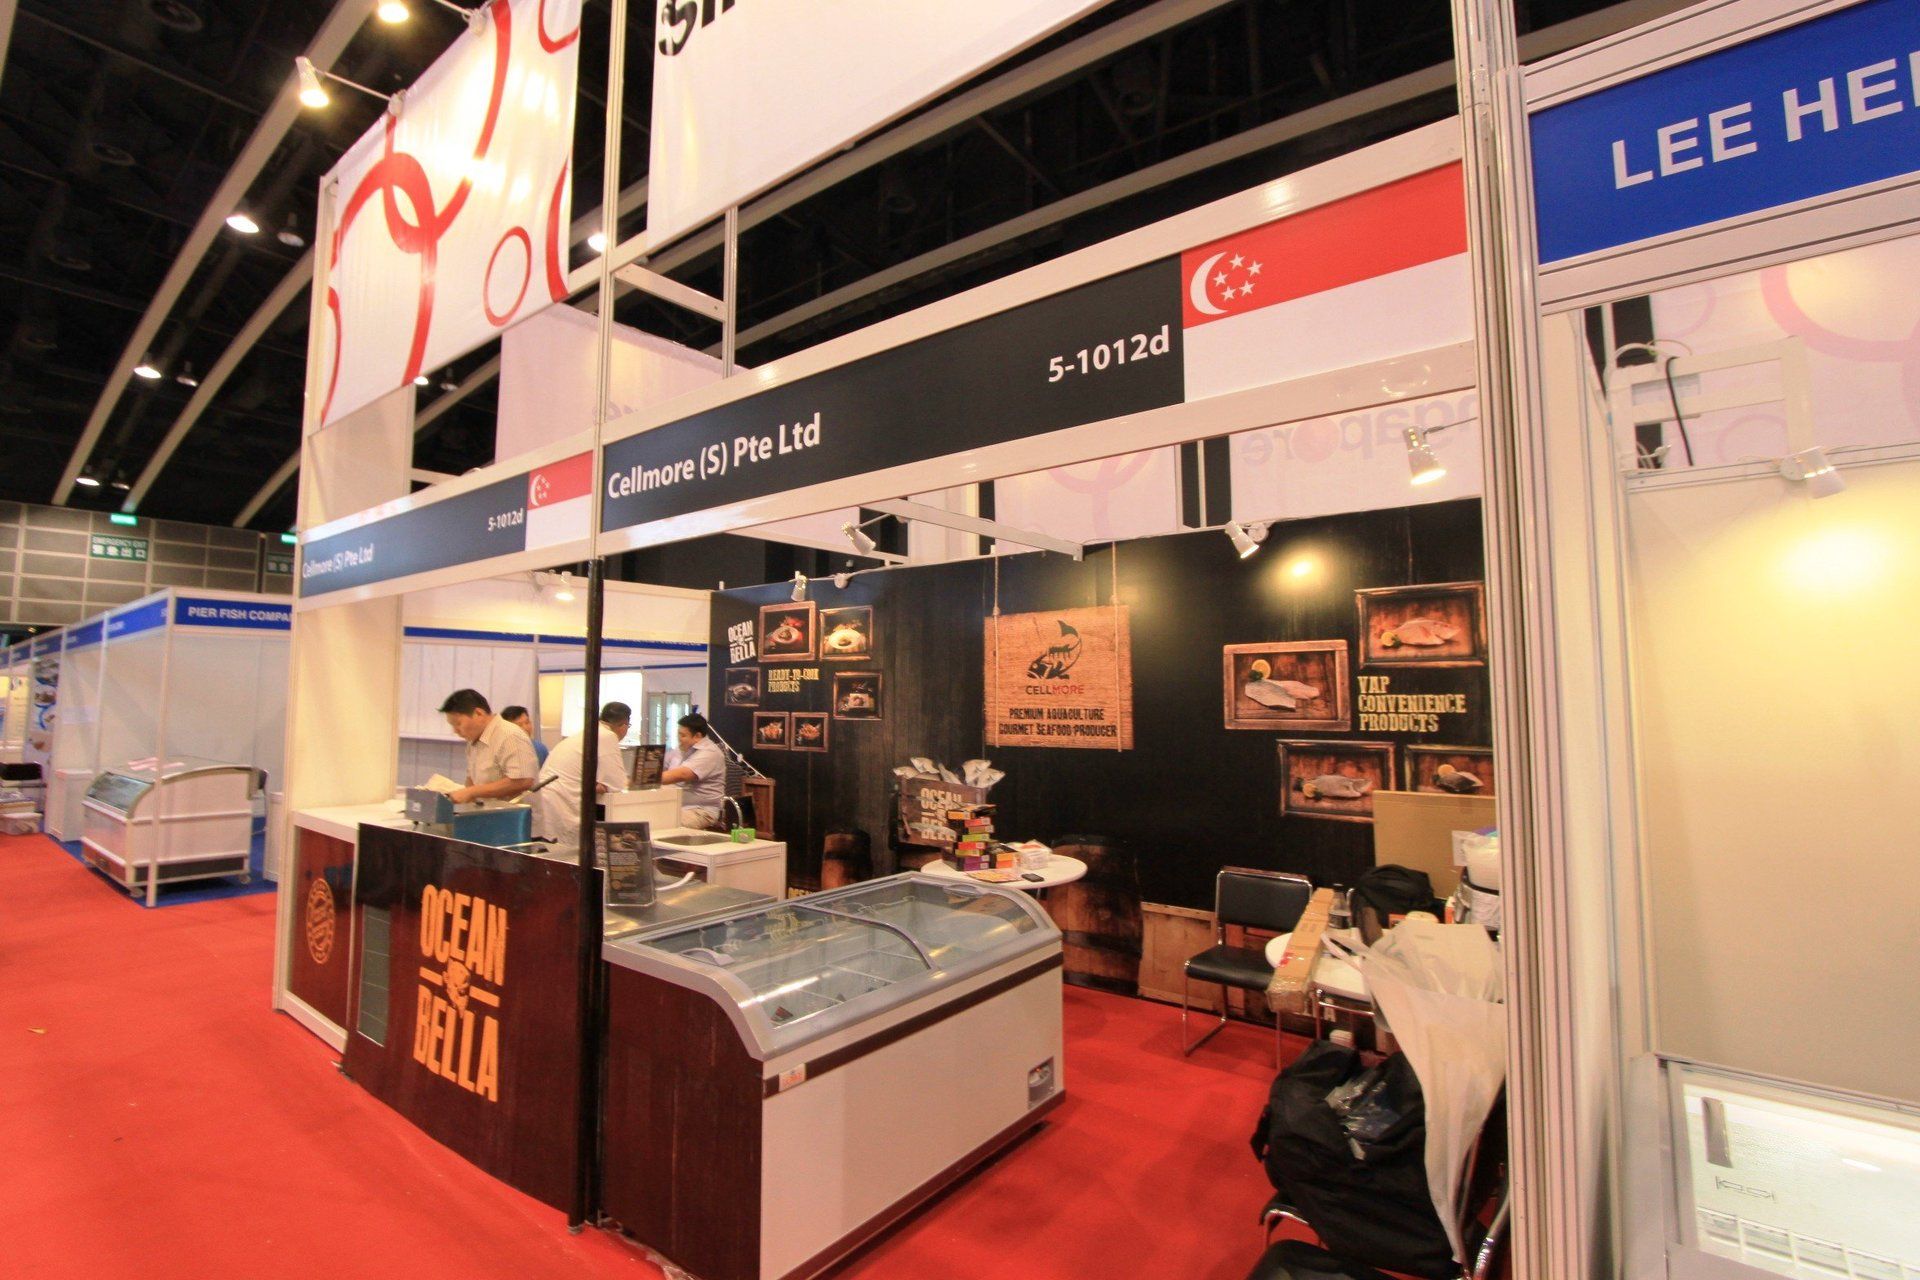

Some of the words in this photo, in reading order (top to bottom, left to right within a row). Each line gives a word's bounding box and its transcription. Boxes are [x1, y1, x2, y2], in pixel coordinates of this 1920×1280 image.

[1612, 102, 1758, 190] LEE
[1783, 50, 1920, 143] HE
[1048, 324, 1171, 383] 5-1012d
[607, 458, 696, 499] Cellmore
[700, 441, 728, 481] (S)
[734, 436, 773, 467] Pte
[779, 411, 821, 455] Ltd
[488, 508, 523, 531] 5-1012d
[303, 559, 333, 578] Cellmore
[333, 552, 343, 573] (S)
[344, 550, 358, 568] Pte
[359, 542, 374, 564] Ltd
[188, 606, 217, 618] PIER
[219, 608, 247, 620] FISH
[248, 610, 292, 622] COMPA
[728, 620, 753, 643] OCEAN
[730, 641, 756, 664] BELLA
[1026, 685, 1084, 695] CELLMORE
[1357, 676, 1390, 694] VAP
[1009, 708, 1043, 719] PREMIUM
[1047, 709, 1104, 720] AQUACULTURE
[1358, 694, 1467, 713] CONVENIENCE
[999, 724, 1033, 735] GOURMET
[1036, 724, 1072, 736] SEAFOOD
[1073, 725, 1117, 737] PRODUCER
[1359, 713, 1439, 732] PRODUCTS
[420, 884, 508, 986] OCEAN
[413, 984, 498, 1102] BELLA
